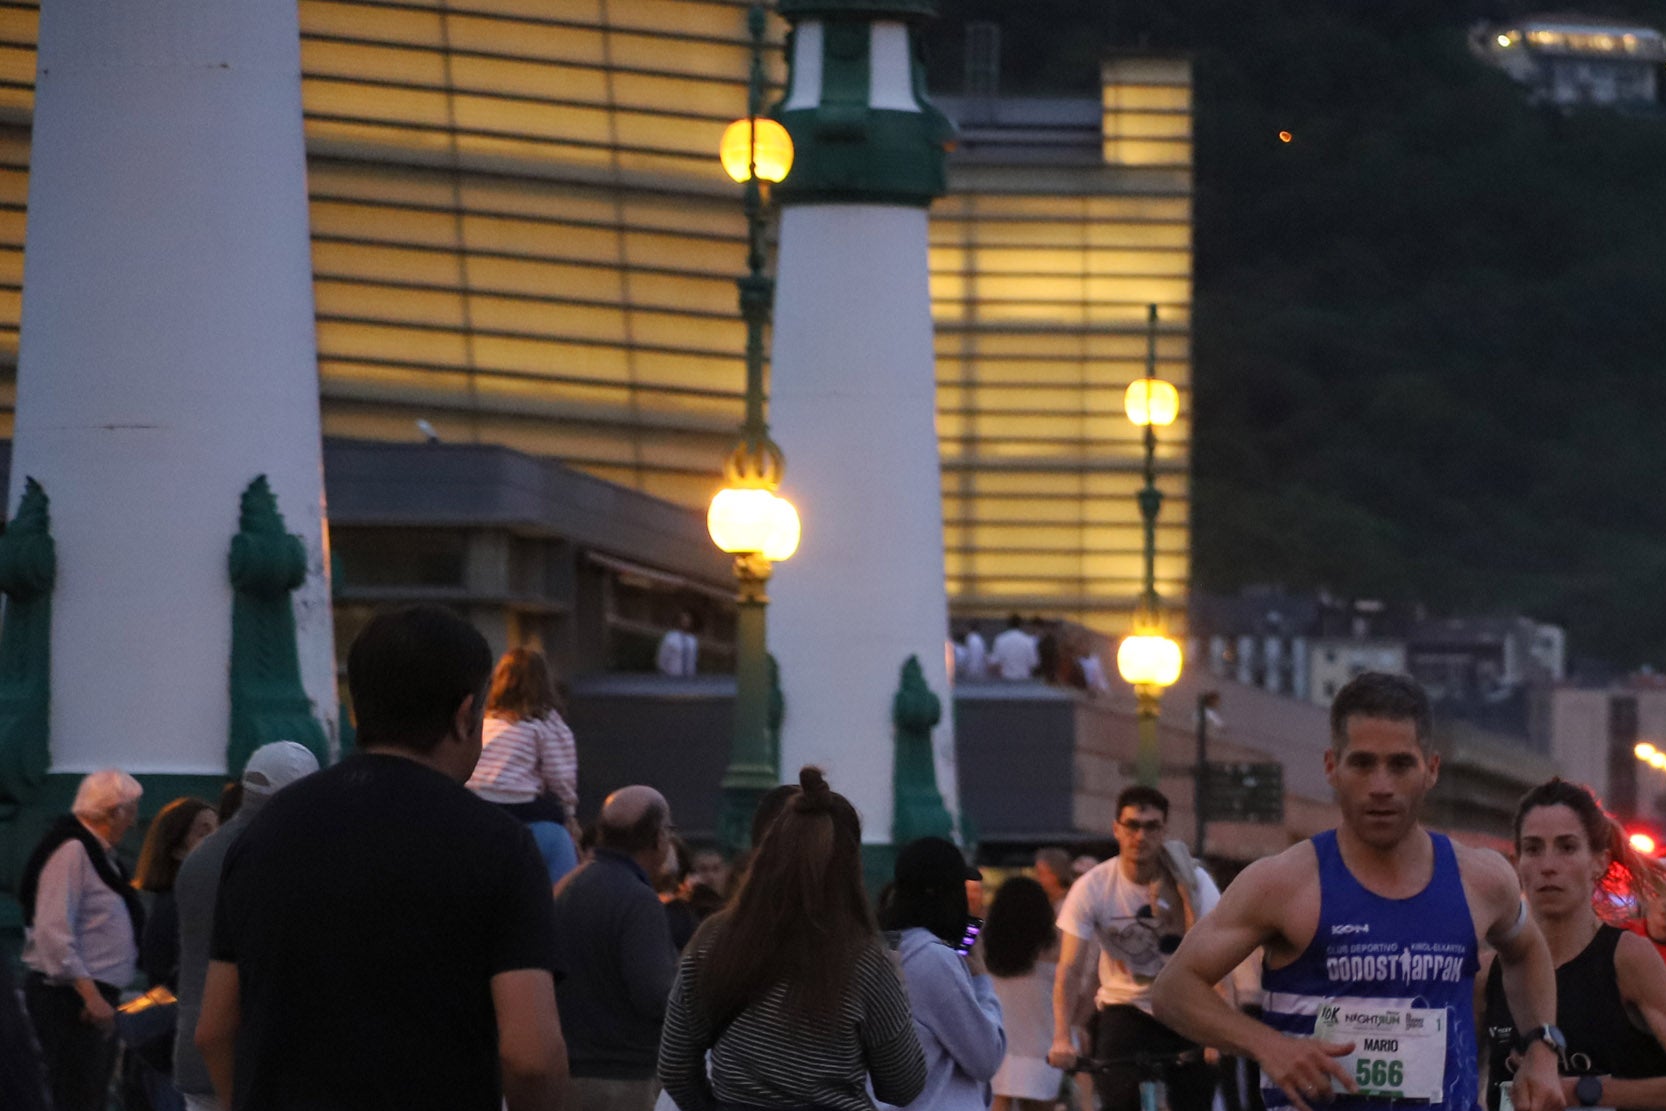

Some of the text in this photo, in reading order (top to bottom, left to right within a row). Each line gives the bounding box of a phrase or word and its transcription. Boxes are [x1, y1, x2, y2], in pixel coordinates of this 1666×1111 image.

[1350, 942, 1399, 953] DEPORTIVO
[1364, 1038, 1399, 1053] MARIO
[1356, 1058, 1404, 1088] 566
